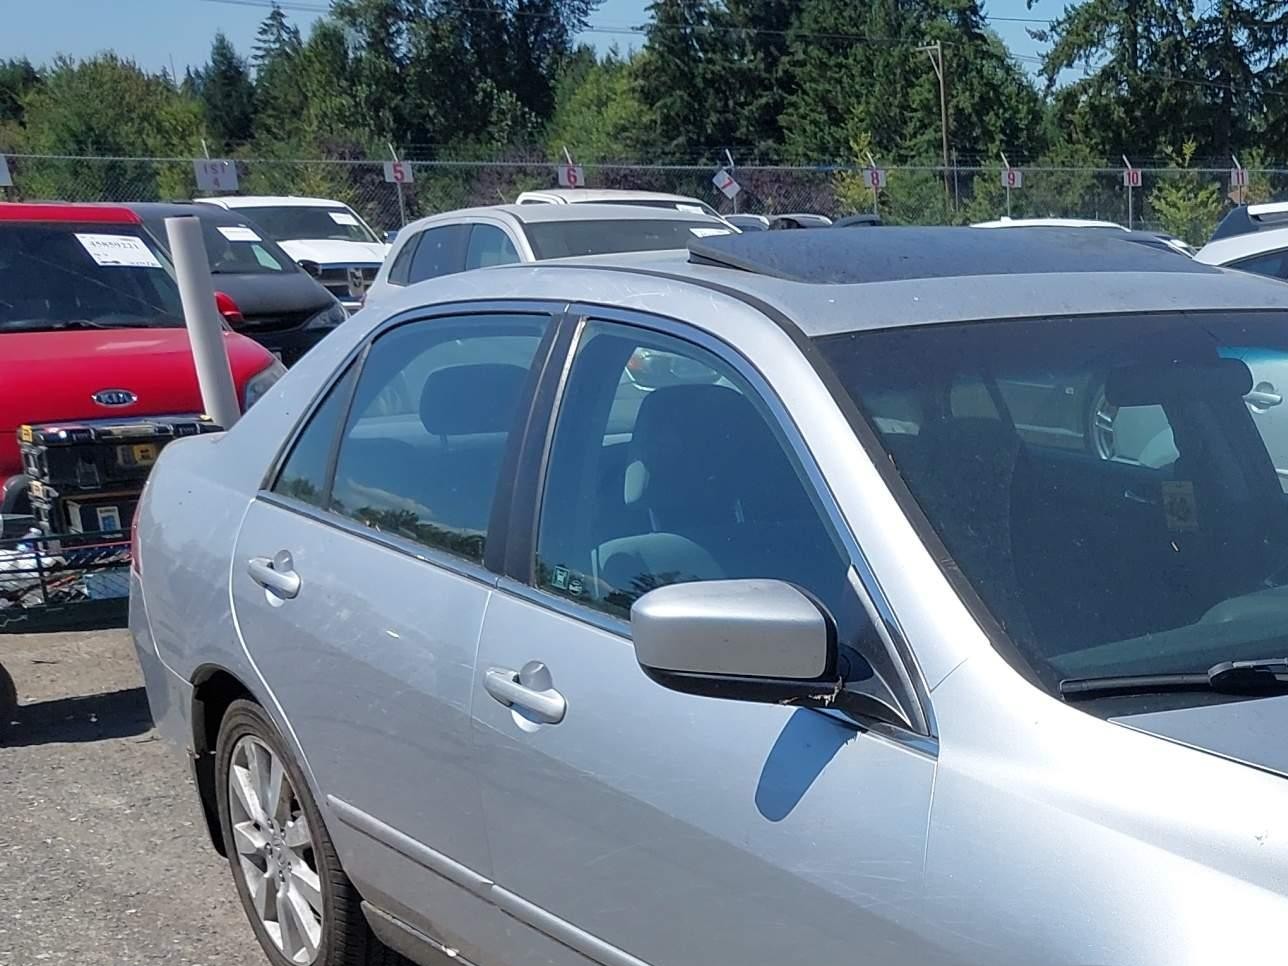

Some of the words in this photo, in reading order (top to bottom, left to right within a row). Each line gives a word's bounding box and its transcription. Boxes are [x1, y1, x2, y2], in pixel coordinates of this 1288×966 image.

[392, 163, 404, 182] 5
[567, 168, 578, 185] 6
[871, 171, 879, 186] 8
[1008, 171, 1015, 186] 9
[1126, 170, 1139, 185] 10
[1235, 170, 1246, 185] 11
[721, 177, 734, 190] 7
